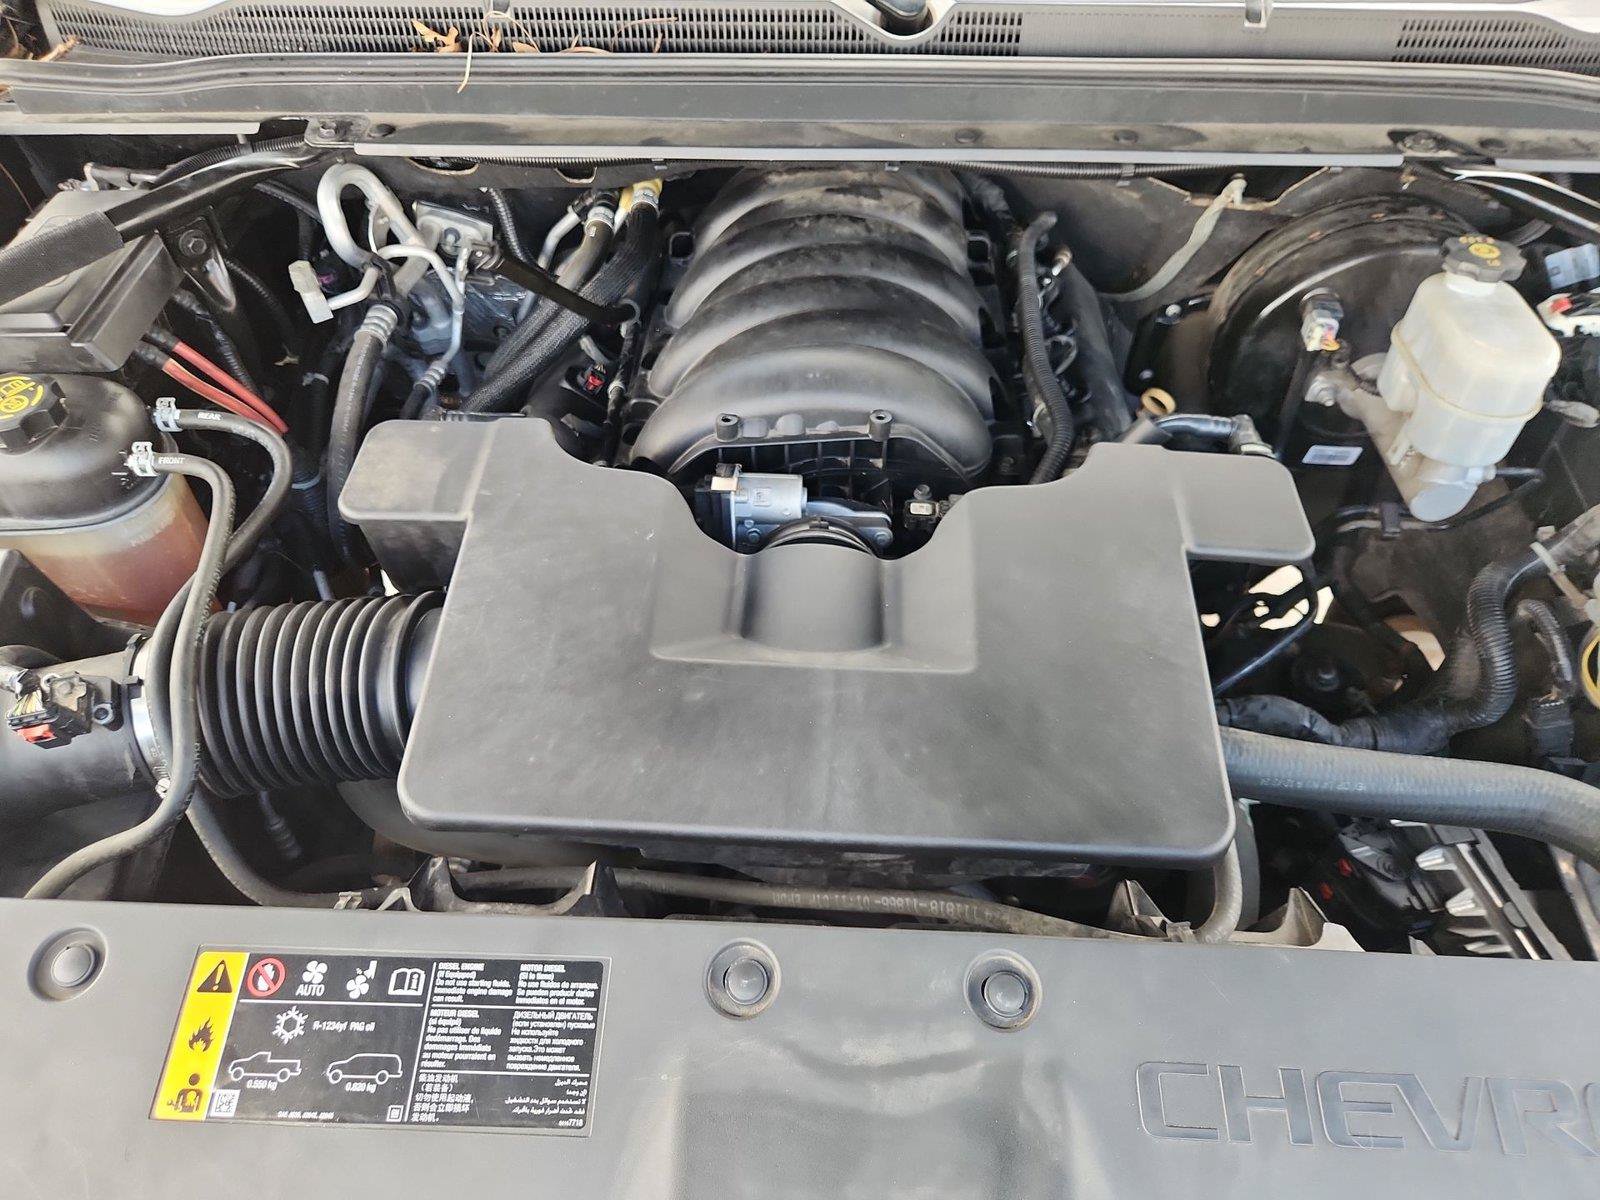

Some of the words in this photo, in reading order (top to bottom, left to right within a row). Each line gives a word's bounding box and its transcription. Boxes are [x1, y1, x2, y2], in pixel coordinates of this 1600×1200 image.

[198, 412, 221, 420] REAR
[544, 964, 565, 972] DIESEL
[536, 972, 554, 980] tiene)
[468, 979, 492, 988] starting
[296, 984, 325, 996] AUTO
[434, 986, 466, 994] Immediate
[466, 987, 487, 996] engine
[488, 988, 513, 997] damage
[457, 1010, 480, 1018] DIESEL
[513, 1011, 555, 1020] ДИЗЕЛЬНЫЙ
[556, 1012, 593, 1020] ДВИГАТЕЛЬ
[313, 1021, 348, 1032] R-1234yf
[350, 1022, 364, 1031] PAG
[366, 1022, 375, 1031] oil
[512, 1020, 529, 1028] (если
[530, 1021, 566, 1029] установлен)
[480, 1027, 502, 1035] liquide
[521, 1029, 559, 1037] используйте
[424, 1043, 458, 1051] dommages
[454, 1052, 487, 1060] pourraient
[419, 1074, 458, 1083] 柴油发动机
[268, 1080, 278, 1090] kg
[367, 1082, 377, 1093] kg
[1136, 1061, 1600, 1157] CHEVR
